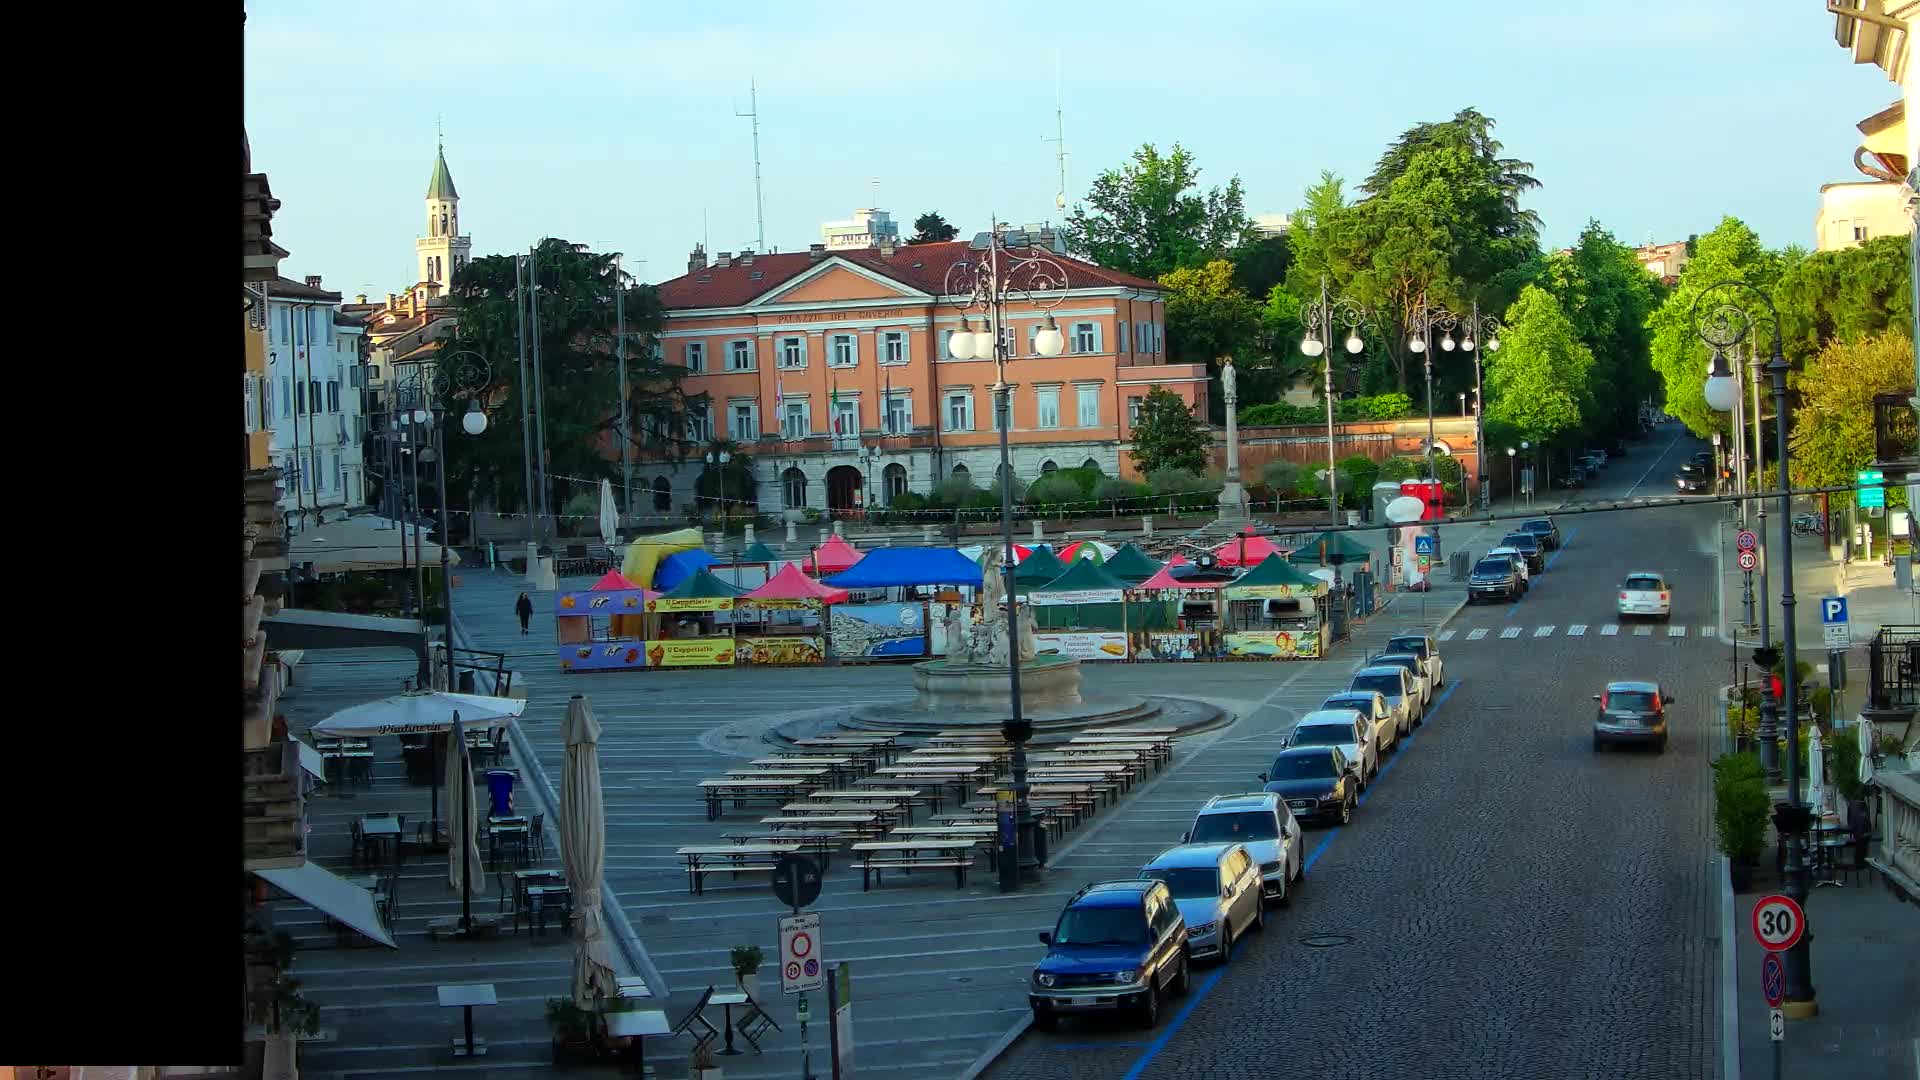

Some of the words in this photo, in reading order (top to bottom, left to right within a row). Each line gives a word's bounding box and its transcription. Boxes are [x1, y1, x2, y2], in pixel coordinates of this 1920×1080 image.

[777, 313, 821, 324] PALAZZO
[831, 312, 847, 321] DEL
[858, 310, 903, 320] GOVERNO
[1742, 556, 1753, 565] 20
[1827, 601, 1842, 620] P
[377, 723, 440, 734] Piadineria
[1762, 910, 1791, 936] 30
